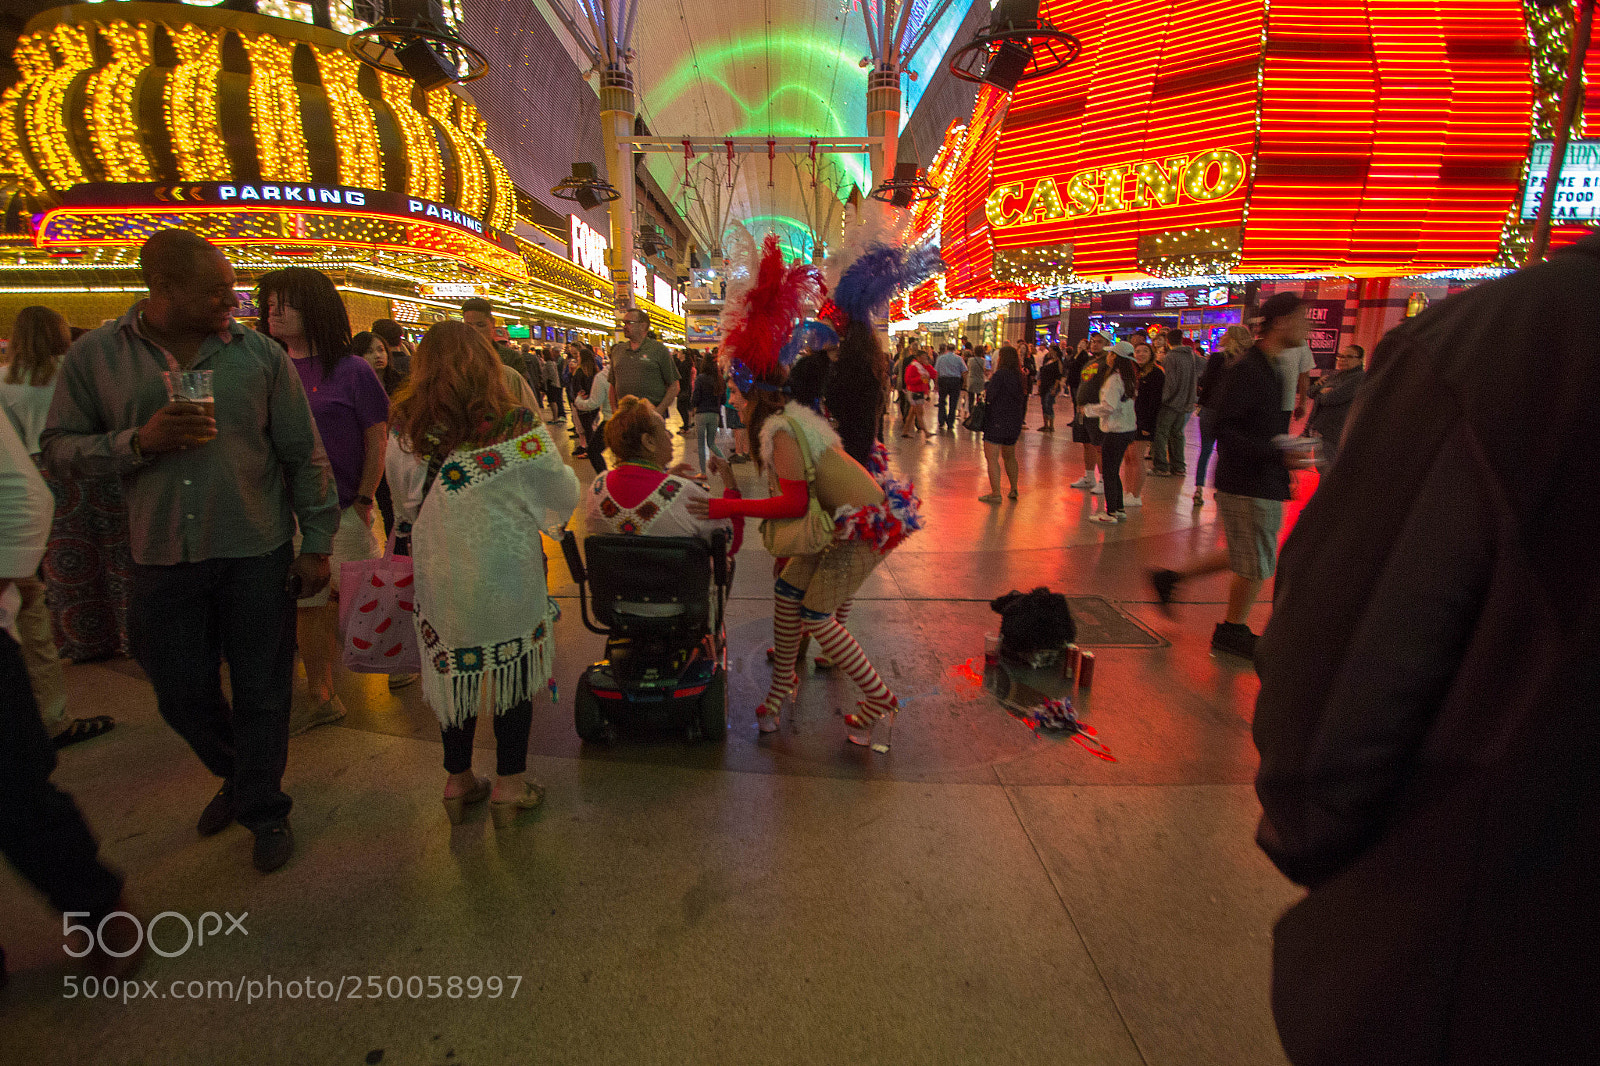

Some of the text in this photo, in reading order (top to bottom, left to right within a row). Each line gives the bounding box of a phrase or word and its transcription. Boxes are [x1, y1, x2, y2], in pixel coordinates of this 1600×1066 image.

[219, 185, 366, 206] PARKING
[985, 148, 1247, 228] CASINO
[409, 199, 483, 234] PARKING
